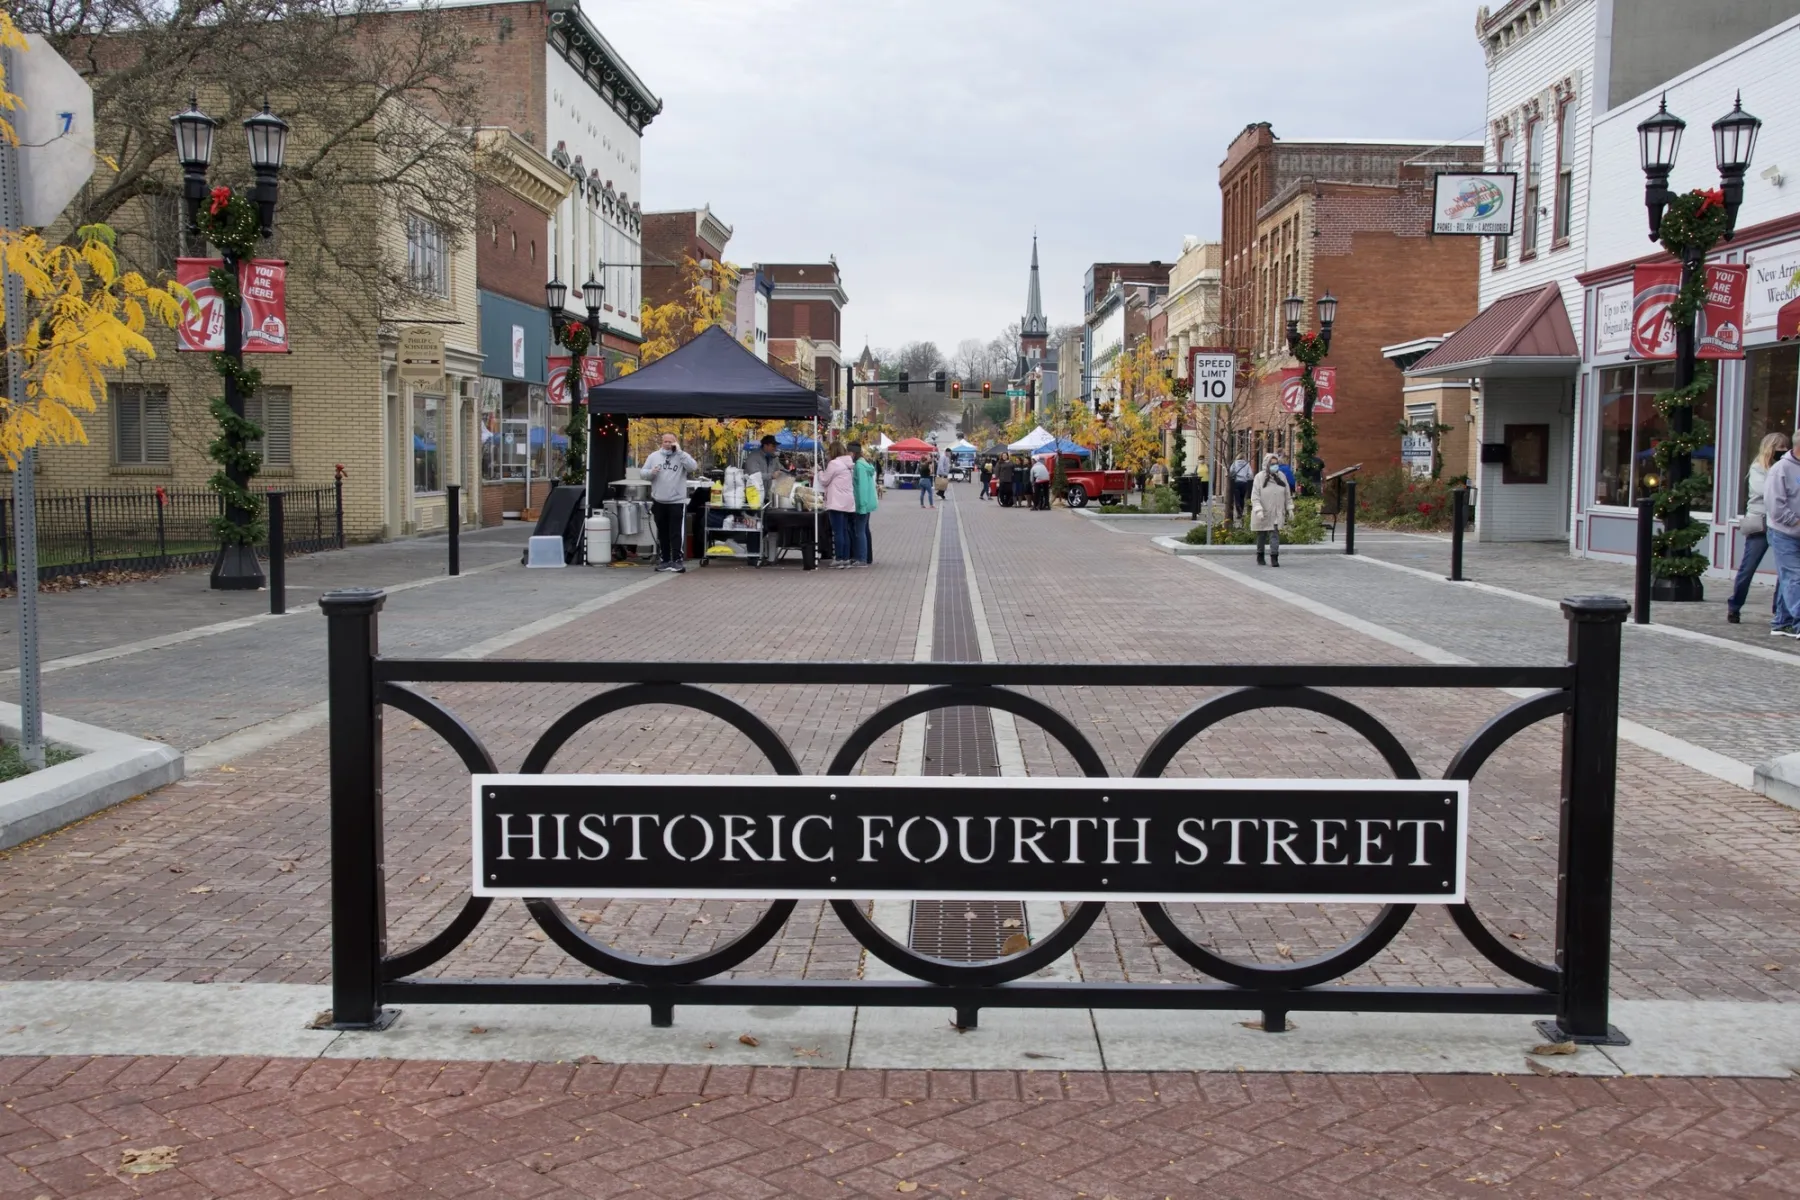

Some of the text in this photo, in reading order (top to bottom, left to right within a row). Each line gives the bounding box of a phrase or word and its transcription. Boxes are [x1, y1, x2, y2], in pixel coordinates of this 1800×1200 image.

[60, 112, 73, 134] 7
[1436, 222, 1453, 232] PHONES
[1456, 222, 1465, 232] BILL
[1466, 222, 1475, 232] PAY
[1482, 222, 1509, 232] ACCESSORIES
[255, 266, 274, 277] YOU
[1715, 270, 1735, 283] YOU
[1756, 260, 1800, 284] New Arri
[253, 277, 271, 288] ARE
[1712, 282, 1732, 294] ARE
[248, 287, 274, 299] HERE!
[1706, 291, 1733, 305] HERE!
[1767, 282, 1798, 303] Weekly
[1604, 304, 1612, 320] Up
[1603, 319, 1623, 338] Original
[1198, 359, 1232, 368] SPEED
[1201, 370, 1228, 378] LIMIT
[1202, 380, 1226, 398] 10
[496, 813, 1445, 867] HISTORIC FOURTH STREET
